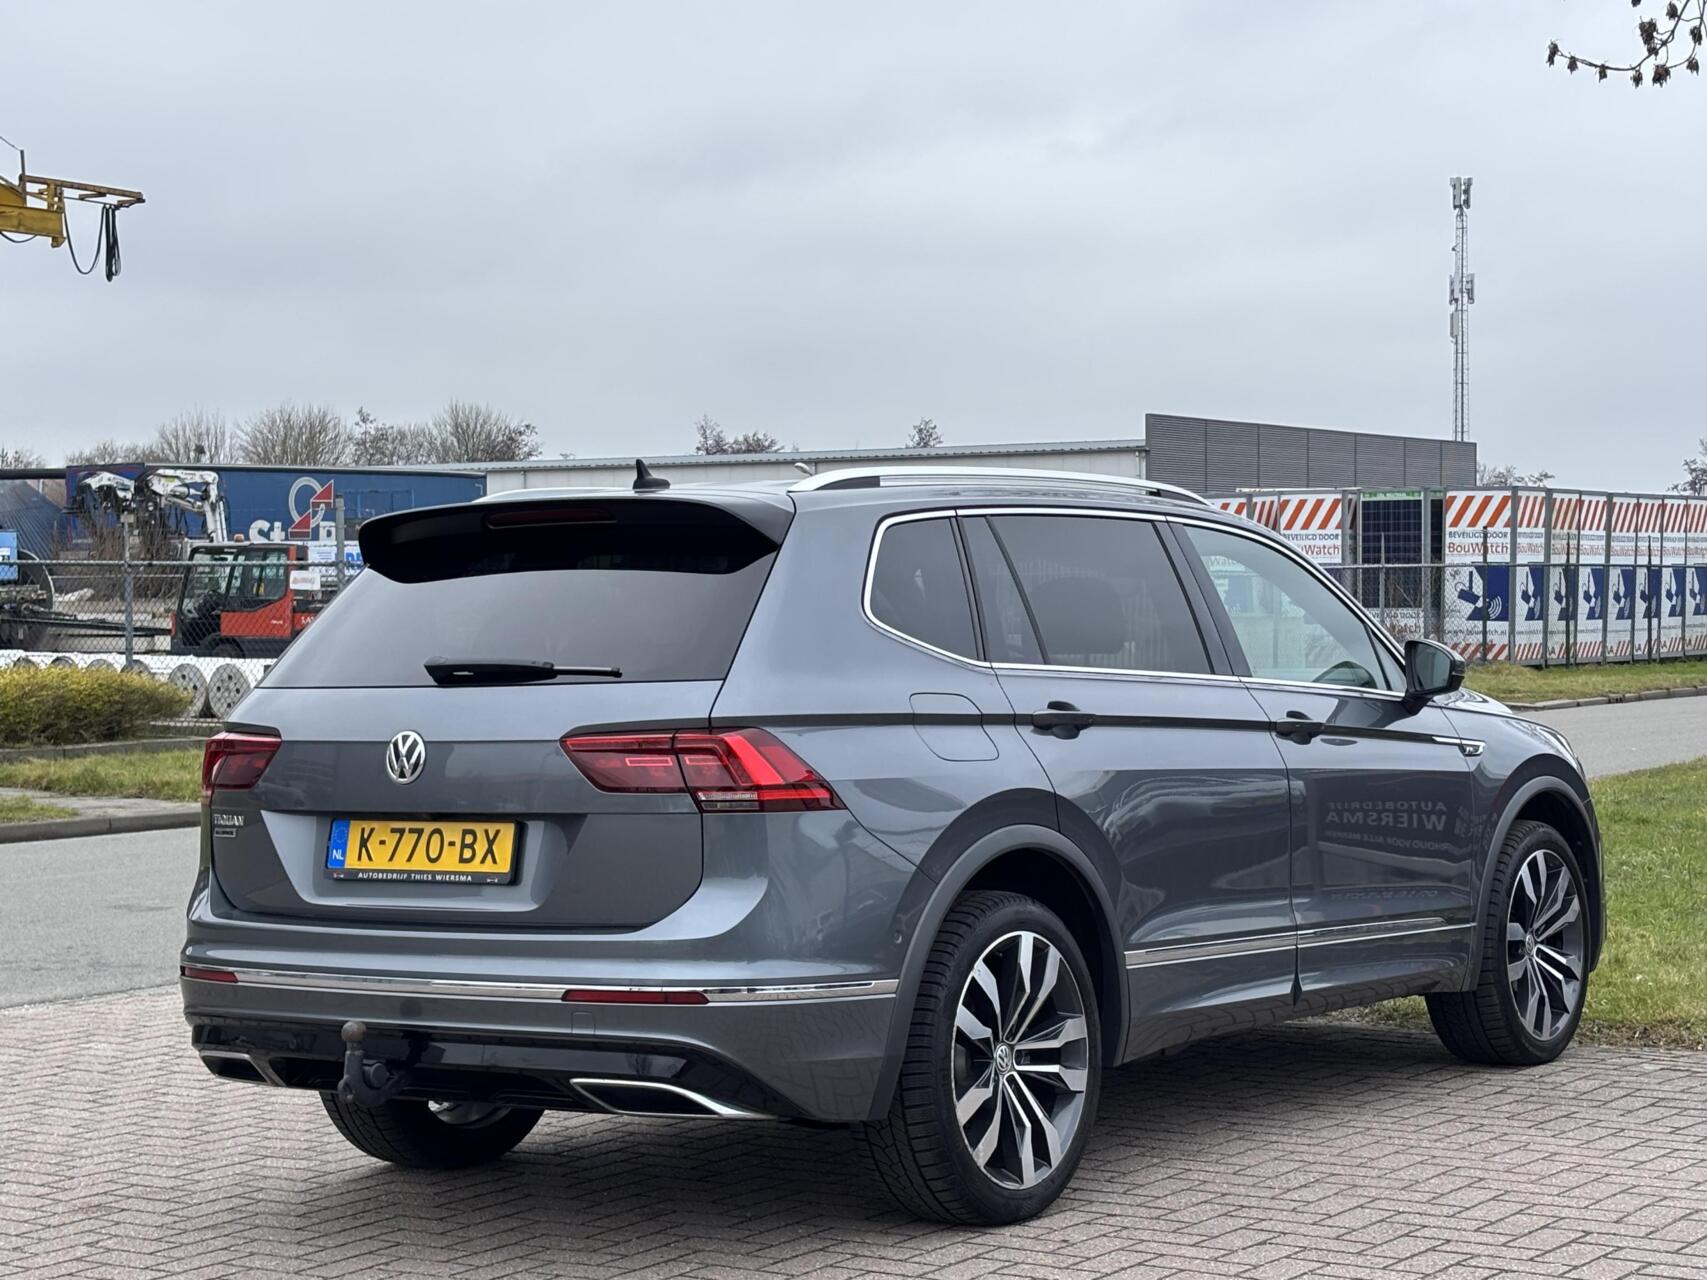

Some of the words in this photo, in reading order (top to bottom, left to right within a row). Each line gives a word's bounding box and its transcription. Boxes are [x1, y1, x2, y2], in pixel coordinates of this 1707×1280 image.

[1301, 543, 1340, 555] Watch
[1448, 542, 1508, 554] BouWtch
[357, 827, 501, 865] K-770-BX
[332, 849, 344, 861] NL
[358, 872, 407, 880] AUTOBEDRIJF
[411, 873, 432, 881] THIES
[436, 874, 472, 882] WIERSMA
